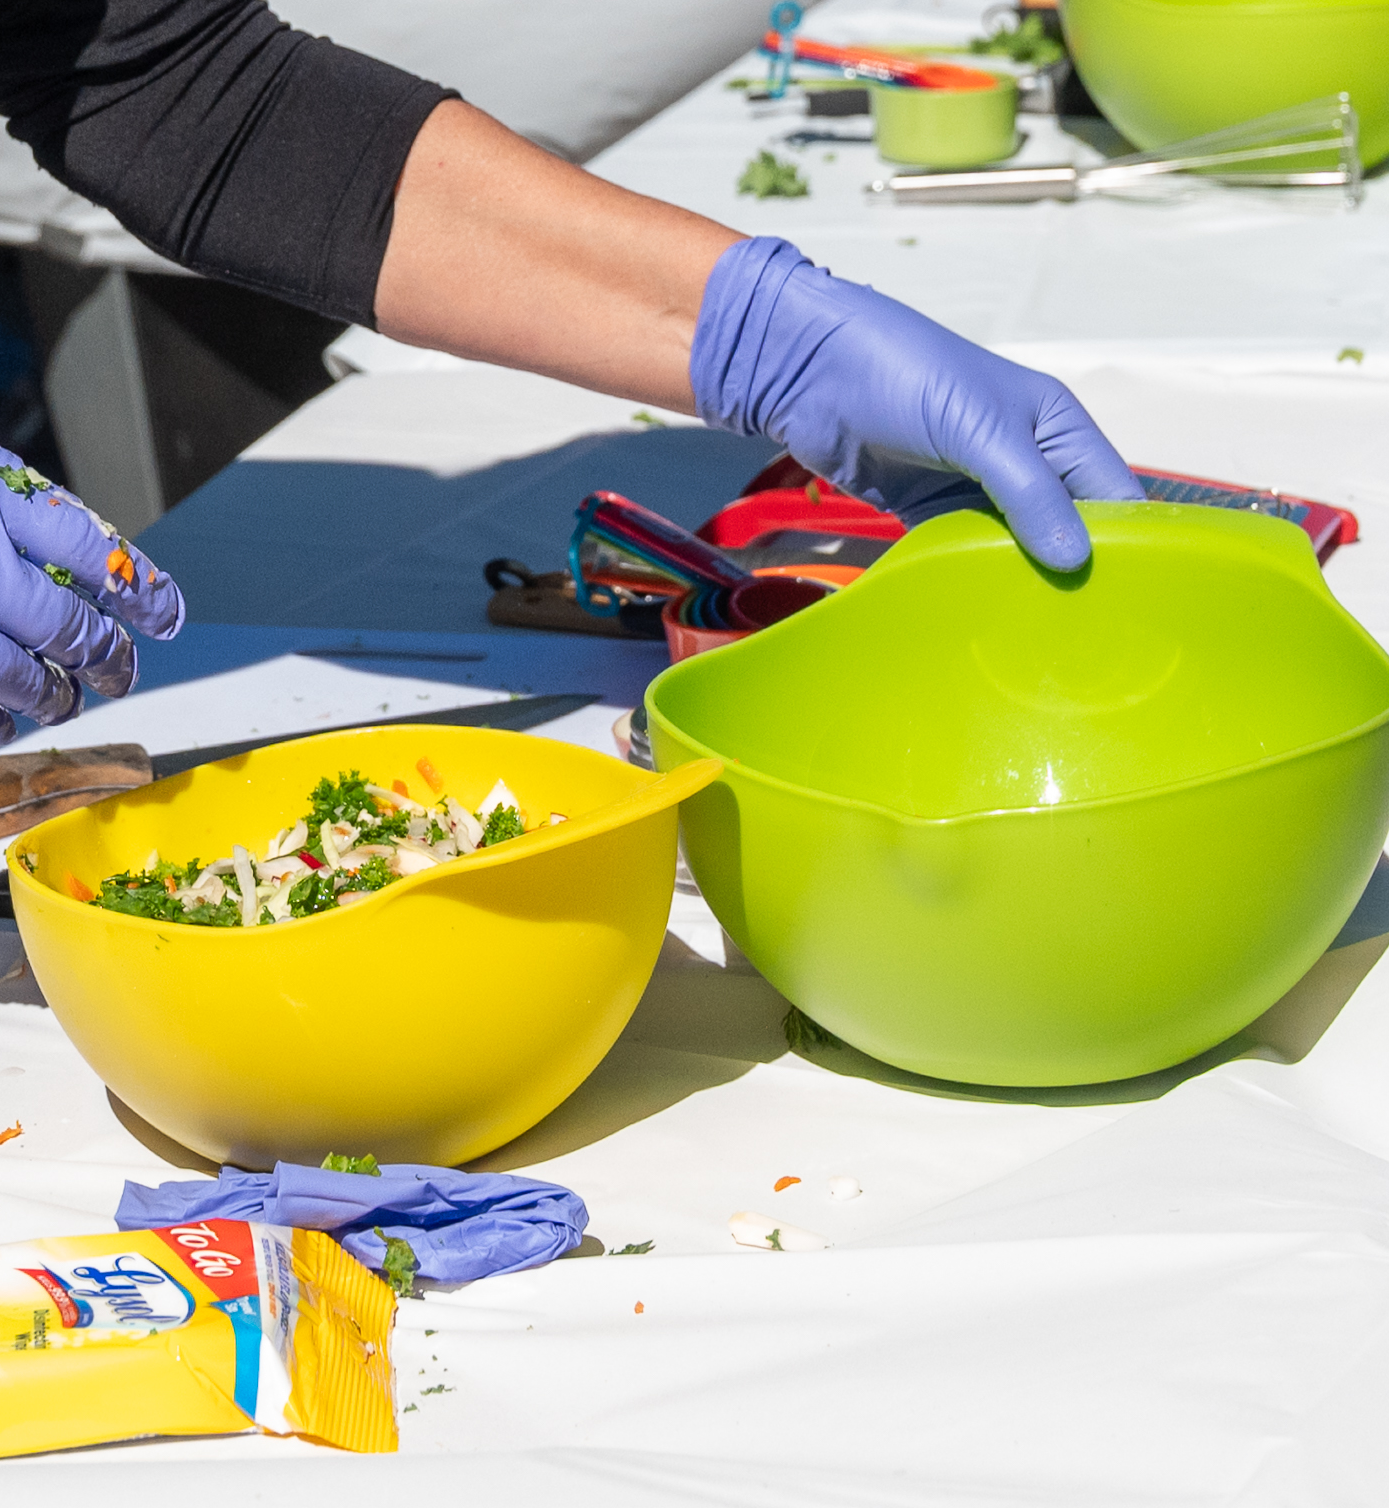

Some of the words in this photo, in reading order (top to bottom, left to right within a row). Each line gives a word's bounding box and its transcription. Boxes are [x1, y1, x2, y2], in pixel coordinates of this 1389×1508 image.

[170, 1223, 219, 1248] To
[190, 1249, 242, 1278] Go
[71, 1255, 181, 1324] Lysol
[33, 1309, 50, 1350] Disinfectin
